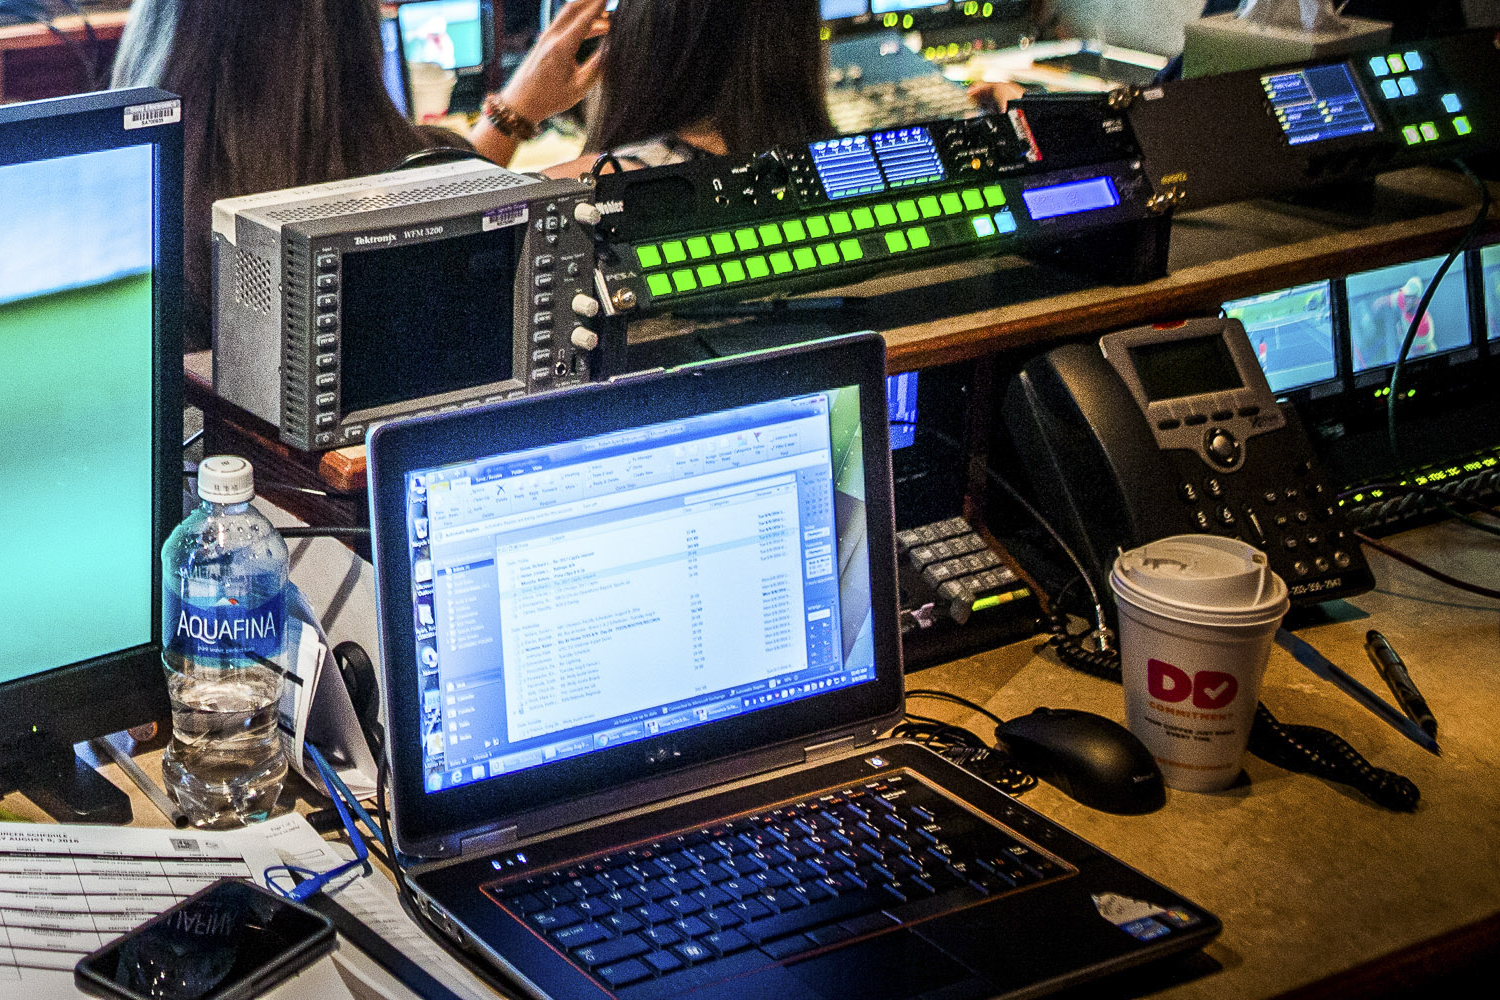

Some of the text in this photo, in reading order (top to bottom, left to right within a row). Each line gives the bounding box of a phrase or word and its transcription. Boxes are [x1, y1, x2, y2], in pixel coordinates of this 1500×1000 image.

[354, 233, 397, 247] Tektronix
[403, 229, 424, 239] WFM
[177, 610, 276, 645] AQUAFINA
